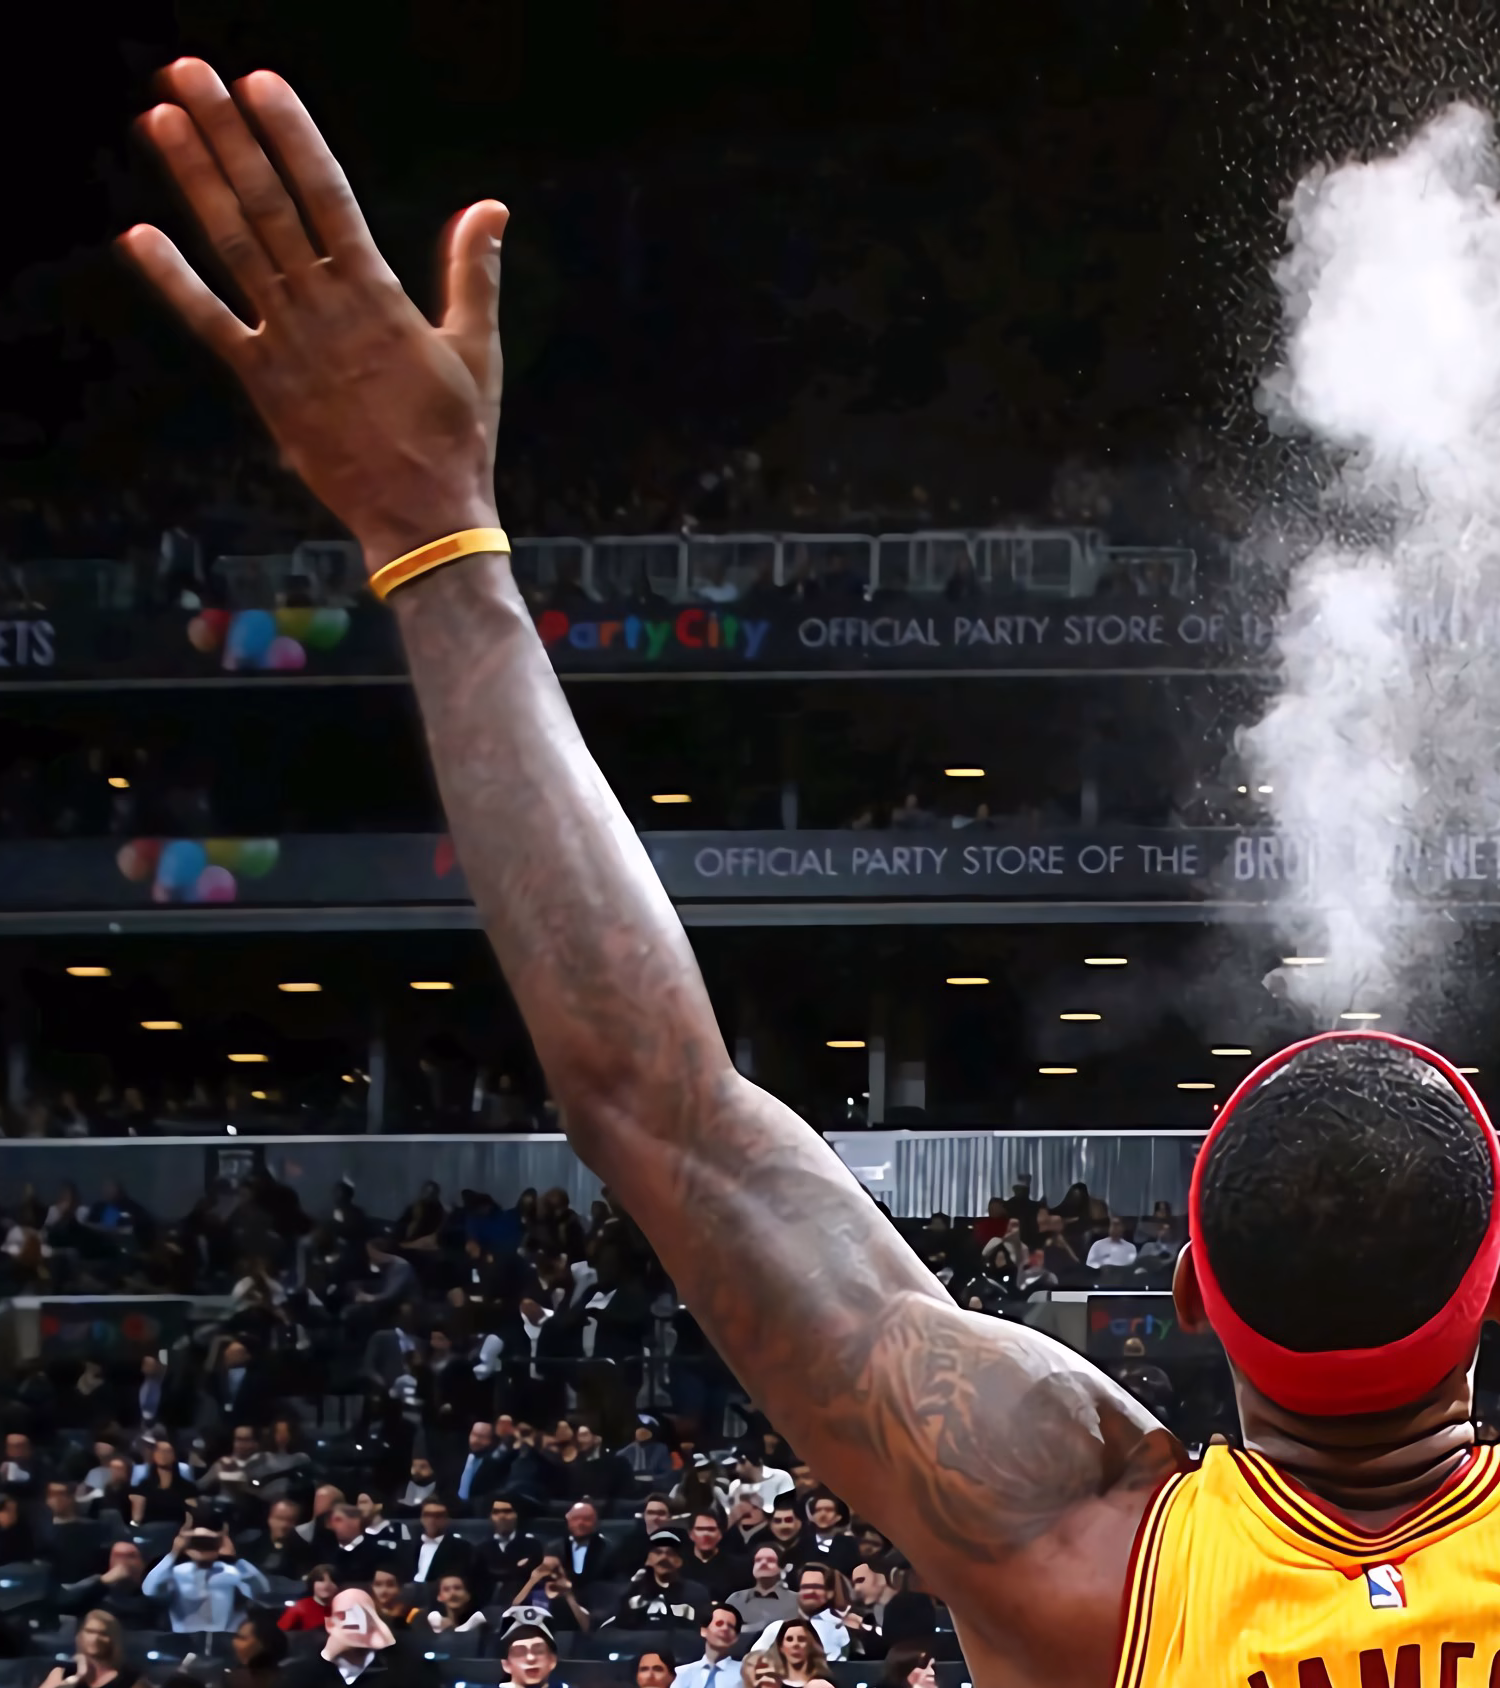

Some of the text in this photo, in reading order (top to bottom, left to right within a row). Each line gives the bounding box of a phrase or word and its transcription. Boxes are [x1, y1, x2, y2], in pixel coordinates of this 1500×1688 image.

[799, 615, 940, 648] OFFICIAL
[954, 615, 1051, 646] PARTY
[1064, 614, 1164, 645] STORE
[1178, 613, 1225, 644] OF
[694, 846, 839, 878] OFFICIAL
[851, 846, 948, 876] PARTY
[962, 845, 1064, 875] STORE
[1078, 844, 1127, 875] OF
[1137, 844, 1197, 875] THE
